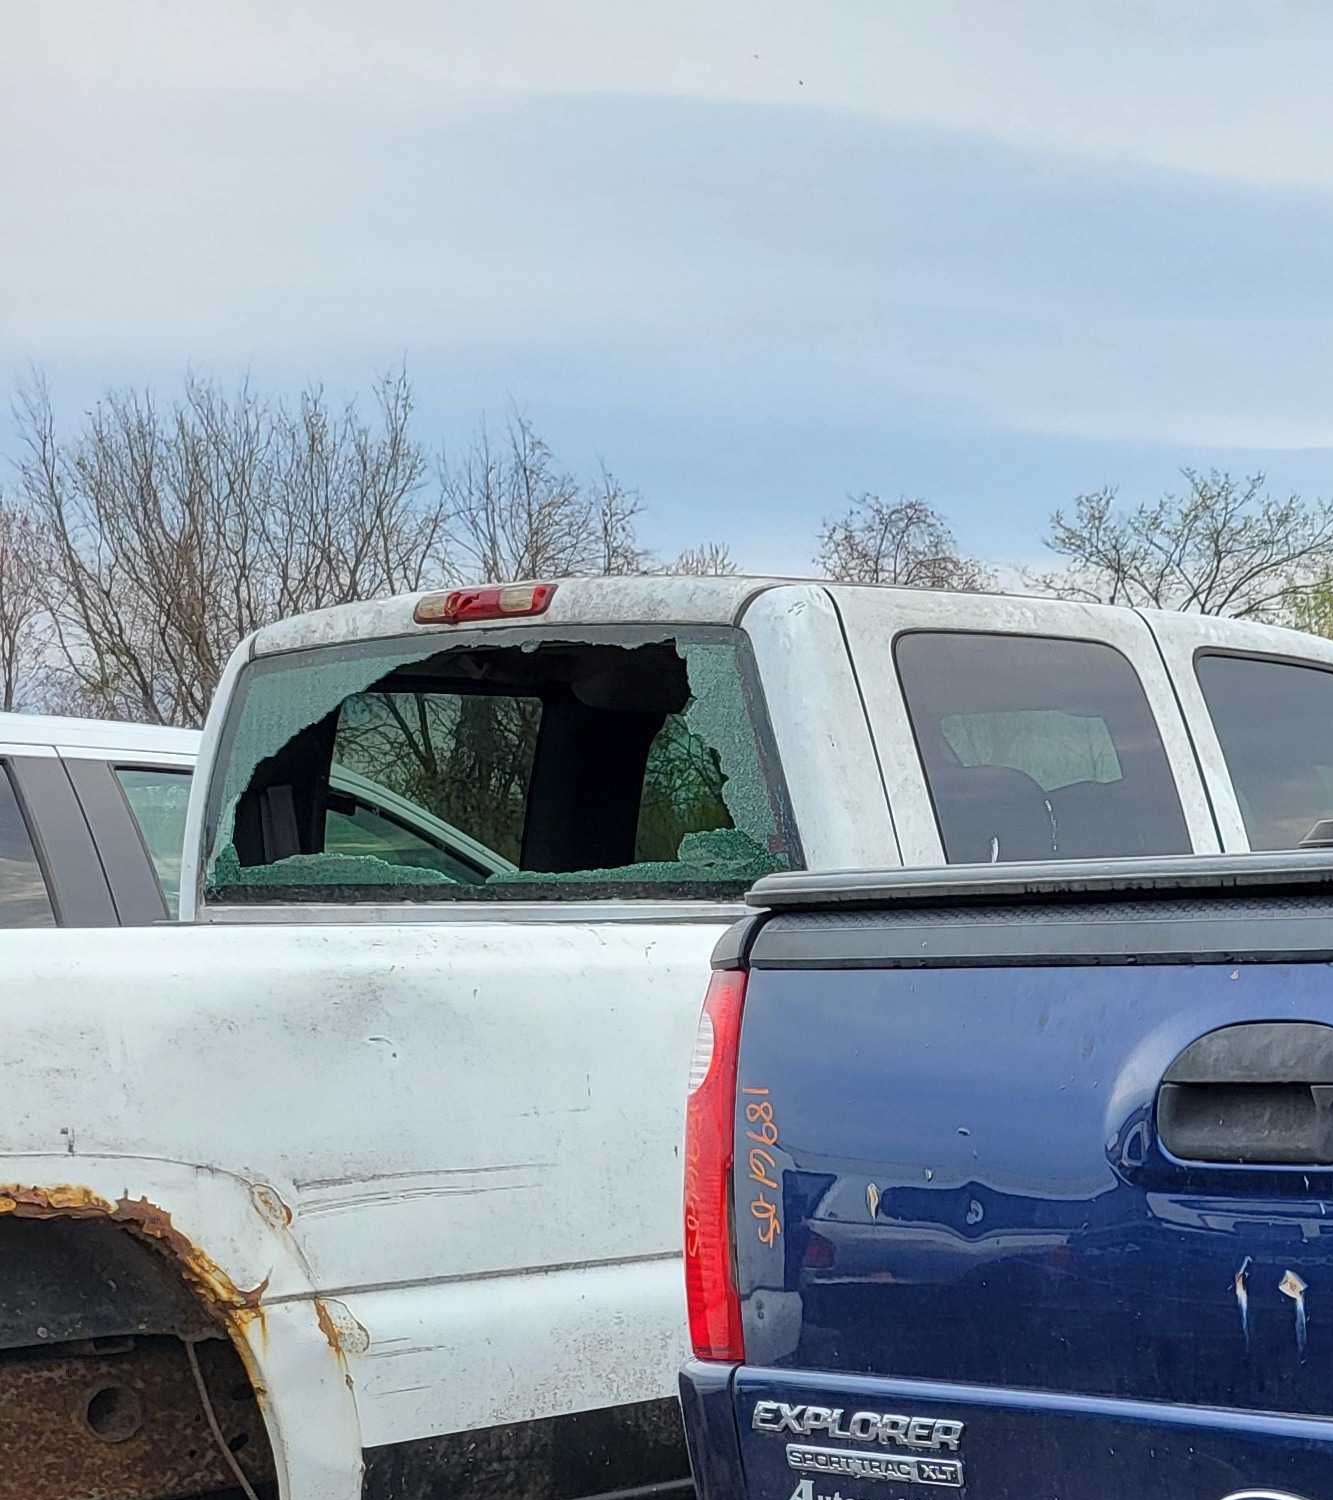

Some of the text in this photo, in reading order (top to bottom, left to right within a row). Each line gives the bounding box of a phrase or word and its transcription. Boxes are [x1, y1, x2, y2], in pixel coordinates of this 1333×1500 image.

[742, 1087, 781, 1249] 18961-05
[752, 1400, 966, 1450] EXPLORER
[789, 1450, 956, 1481] SPORT TRAC XLT
